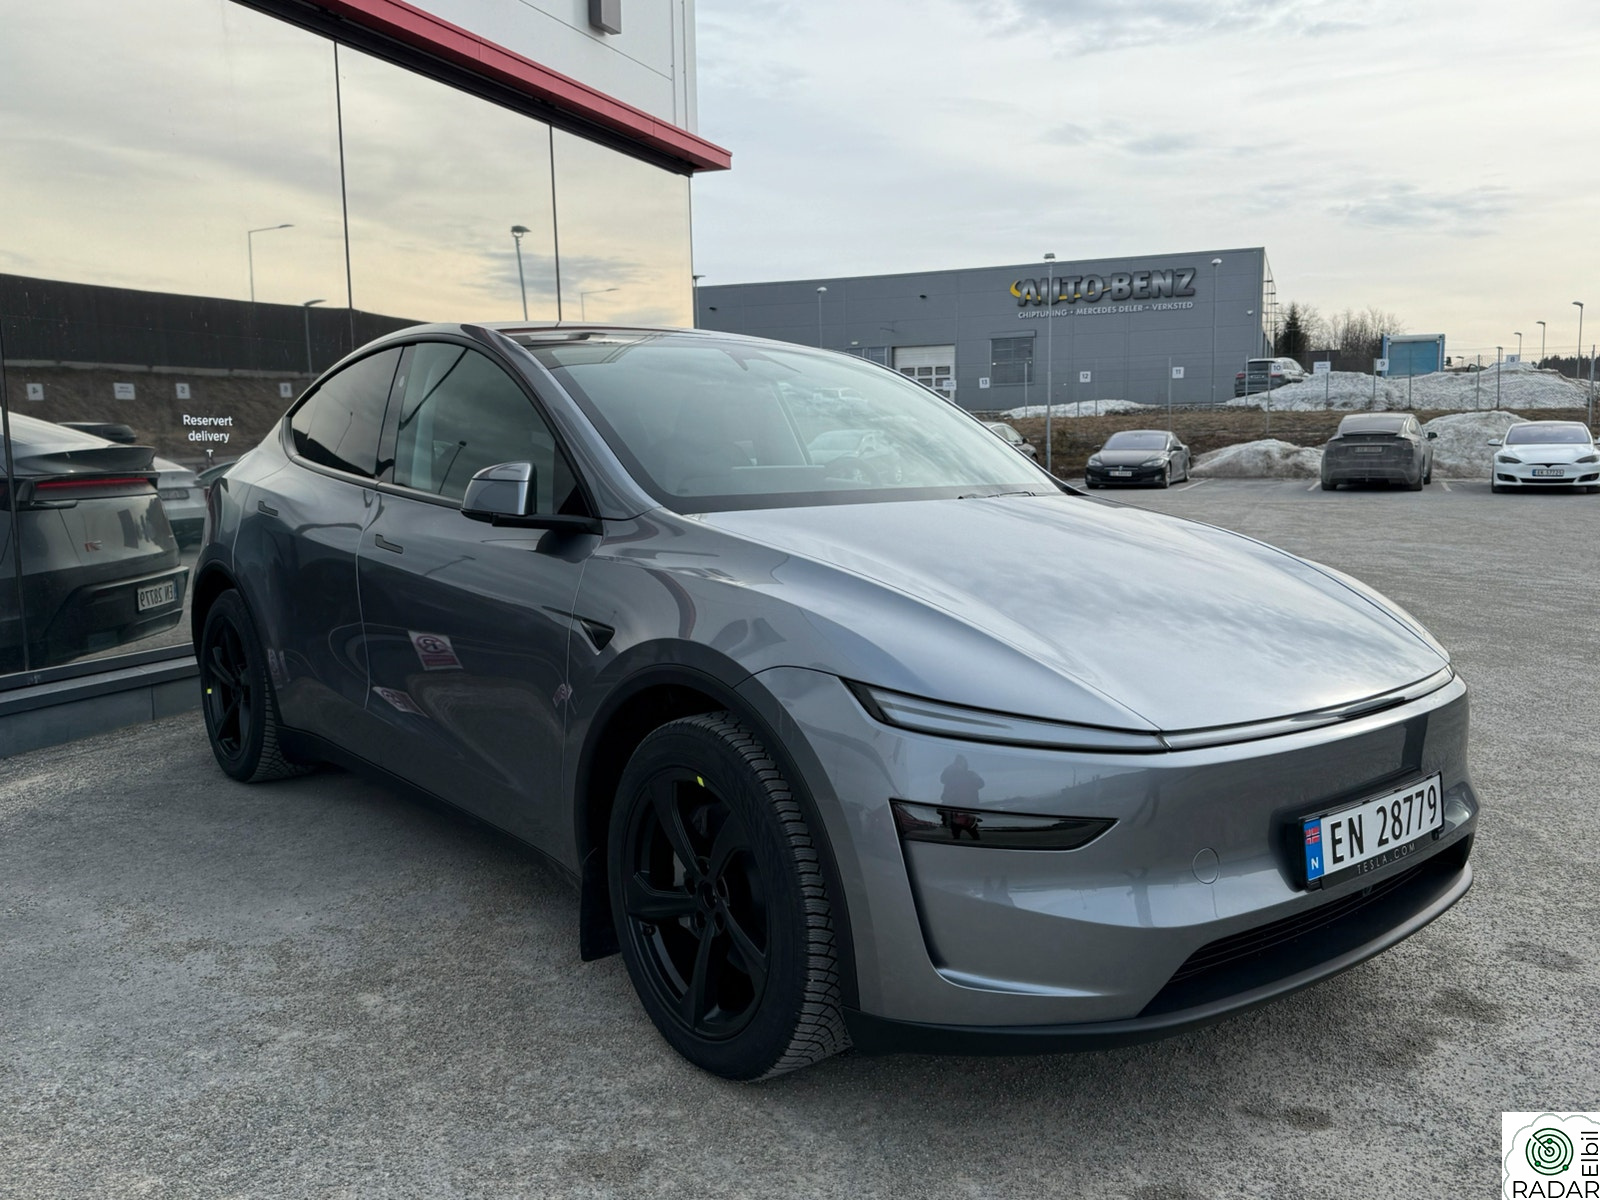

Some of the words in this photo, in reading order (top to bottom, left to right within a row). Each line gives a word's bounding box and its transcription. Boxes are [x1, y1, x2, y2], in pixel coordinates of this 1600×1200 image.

[1110, 267, 1196, 301] BENZ
[1018, 308, 1068, 319] CHIPTUNING
[1076, 304, 1117, 316] MERCEDES
[1118, 304, 1143, 313] DELER
[1152, 301, 1194, 311] VERKSTED
[1380, 360, 1386, 368] 9
[182, 414, 233, 427] Reservert
[188, 430, 230, 444] delivery
[1330, 814, 1365, 866] EN
[1375, 784, 1437, 848] 28779
[1311, 856, 1319, 871] N
[1356, 843, 1416, 875] TESLA.COM
